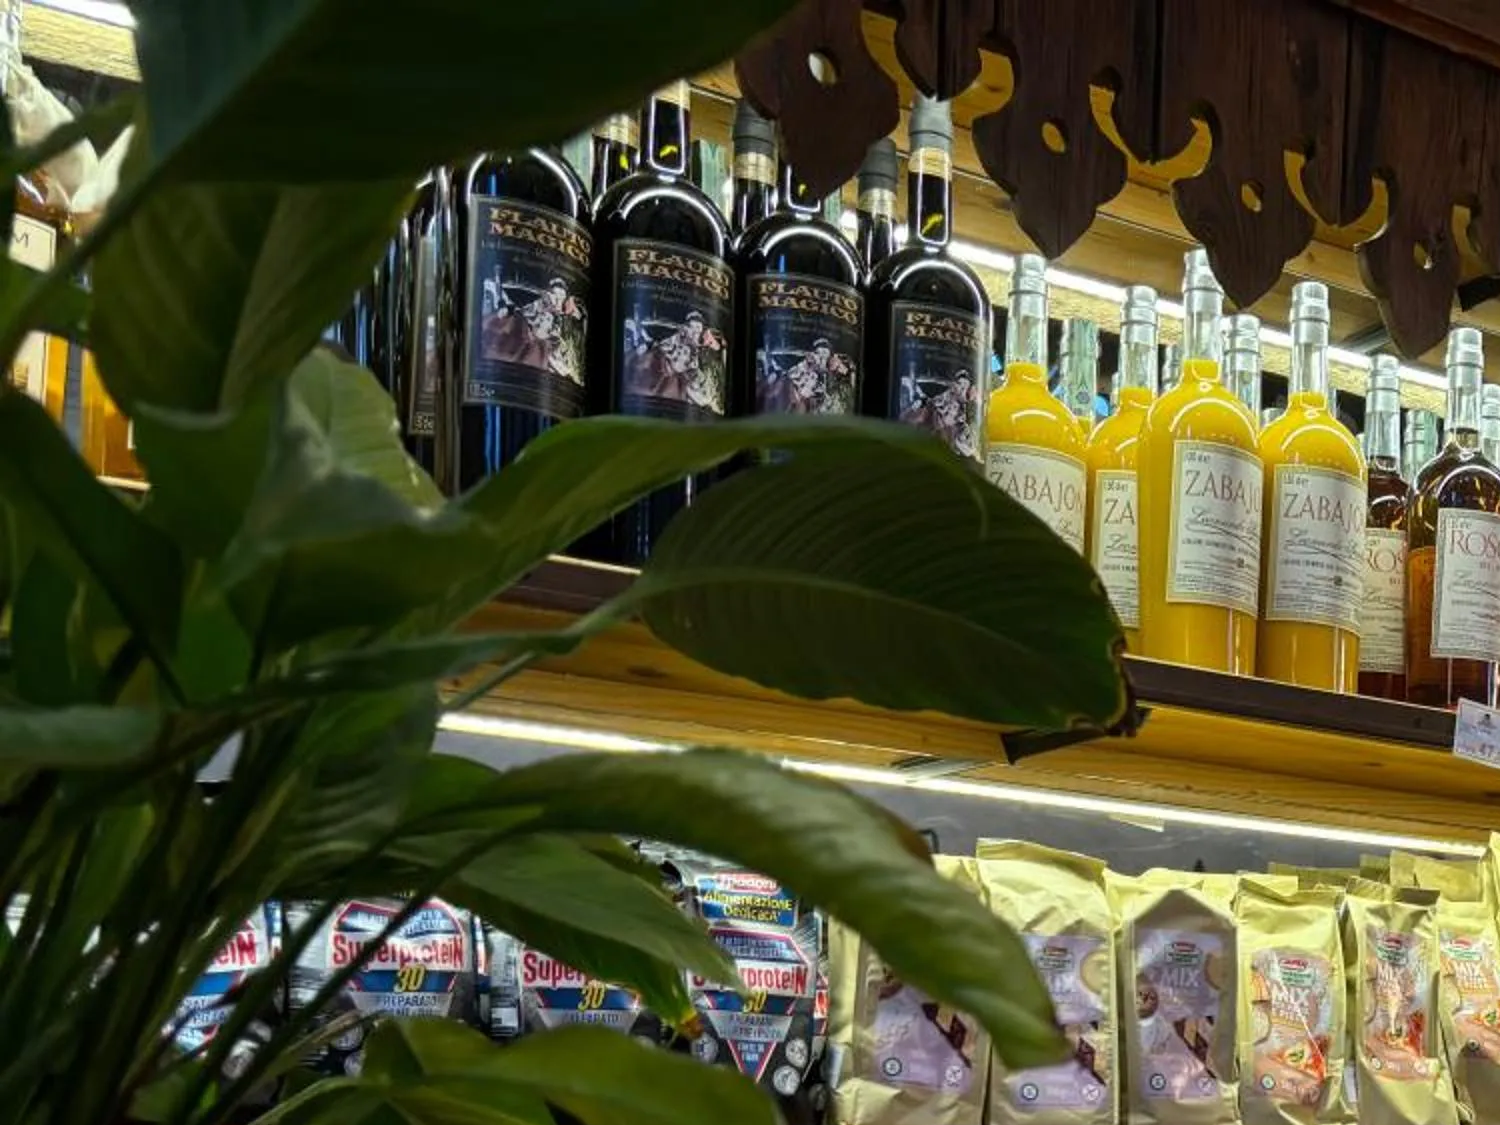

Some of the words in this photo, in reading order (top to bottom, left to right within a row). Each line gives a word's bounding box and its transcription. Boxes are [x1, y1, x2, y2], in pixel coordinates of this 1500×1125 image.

[489, 207, 592, 254] FLAUTO
[489, 221, 591, 267] MAGICO
[627, 263, 730, 300] MAGICO
[628, 249, 731, 287] FLAUTO
[758, 296, 858, 325] MAGICO
[759, 282, 858, 311] FLAUTO
